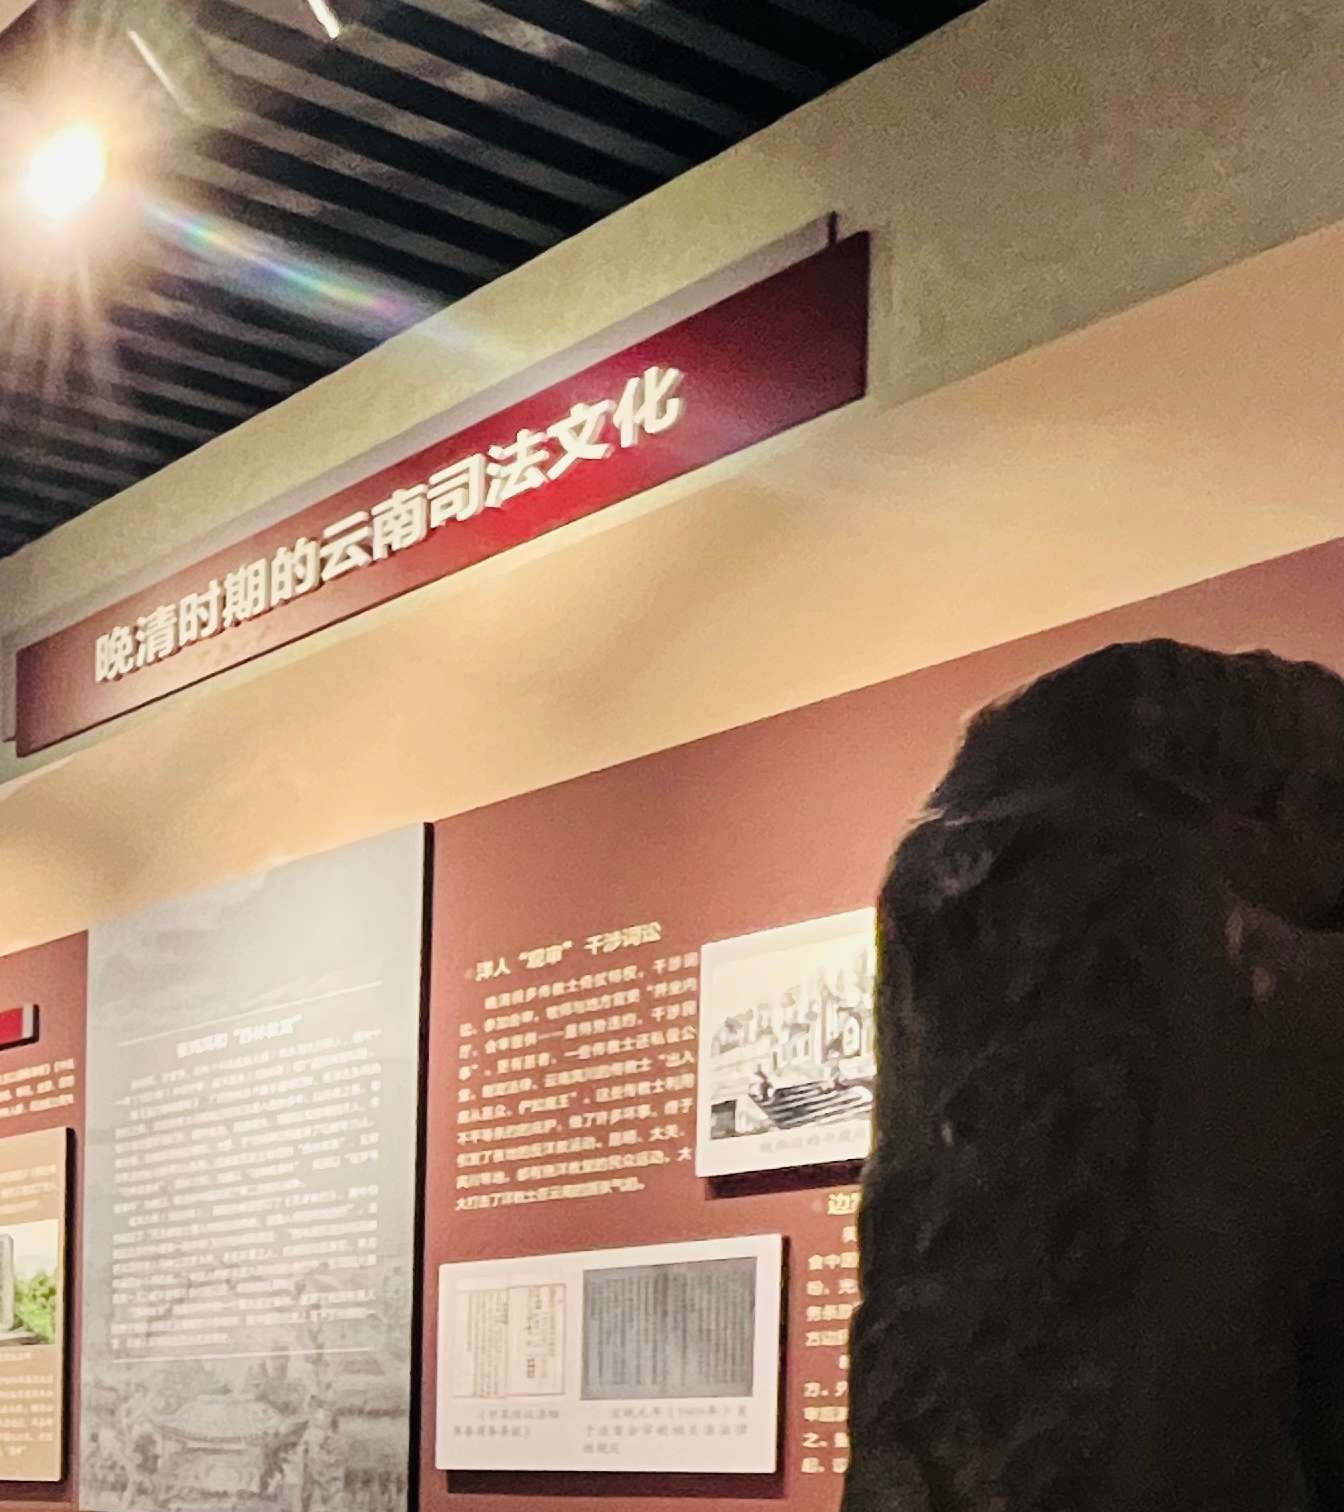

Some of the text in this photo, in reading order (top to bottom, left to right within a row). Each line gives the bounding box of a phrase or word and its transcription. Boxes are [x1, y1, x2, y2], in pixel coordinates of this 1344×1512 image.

[93, 364, 685, 684] 晚清时期的云南司法文化
